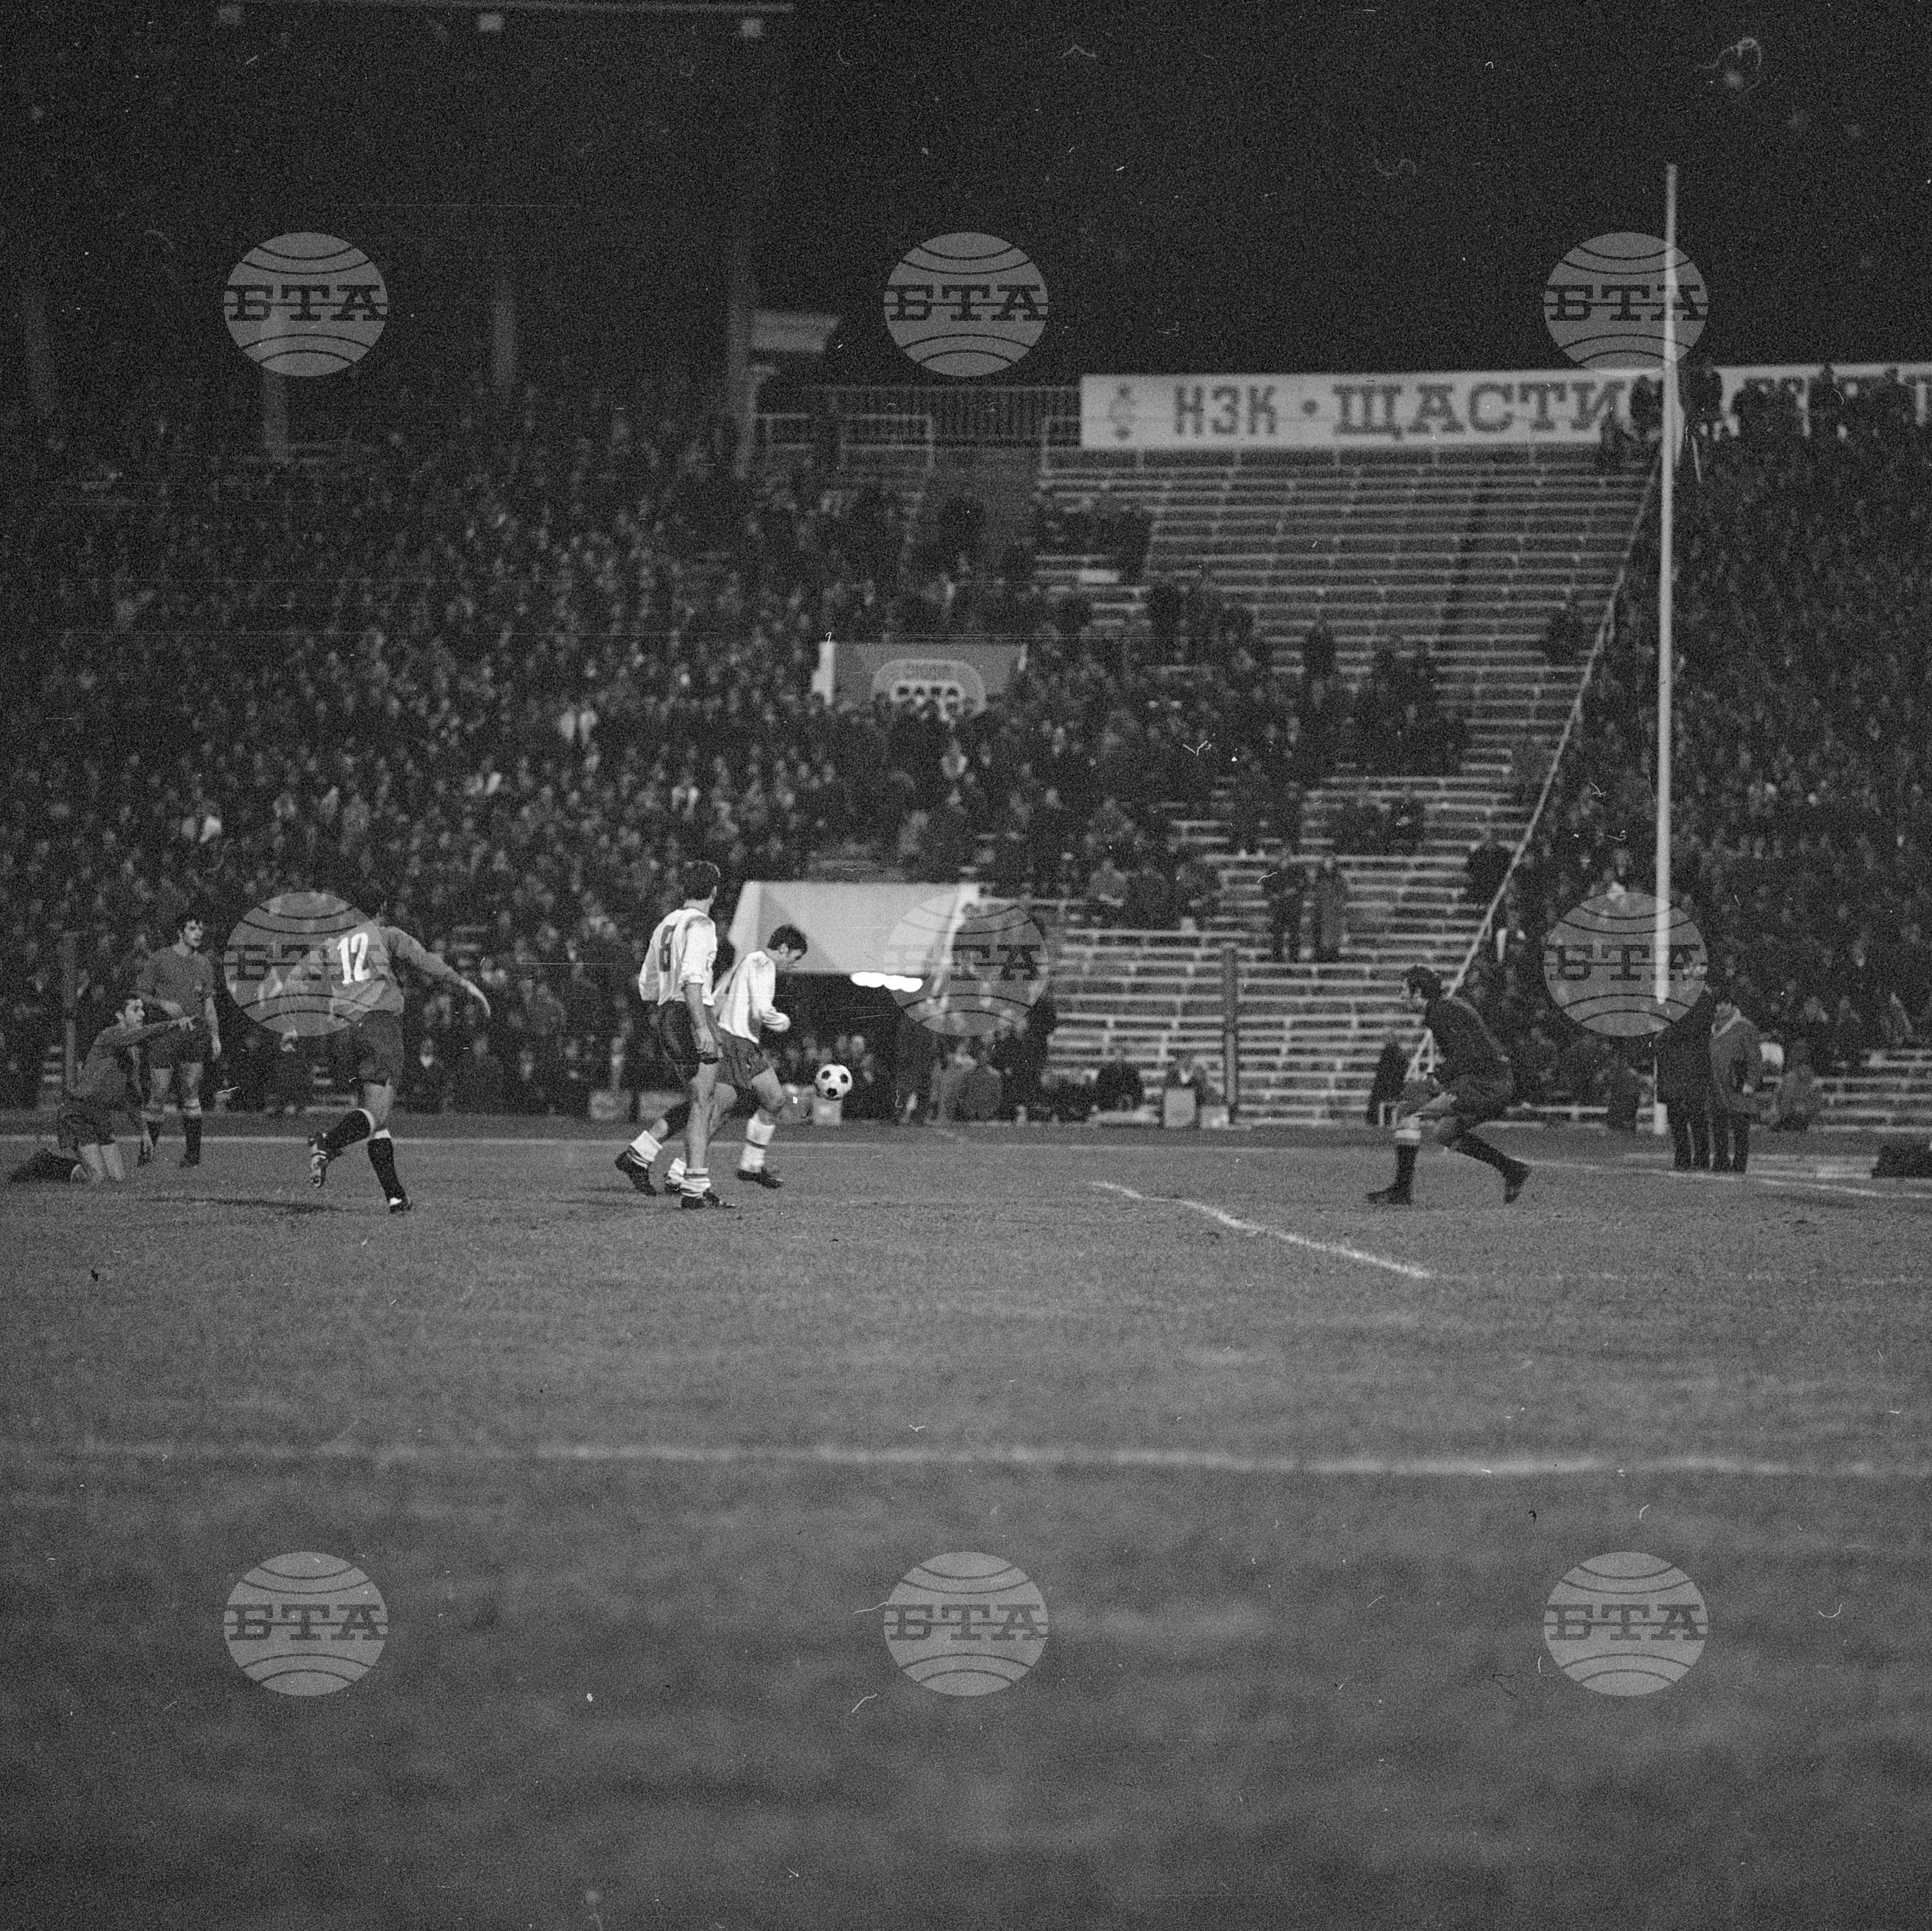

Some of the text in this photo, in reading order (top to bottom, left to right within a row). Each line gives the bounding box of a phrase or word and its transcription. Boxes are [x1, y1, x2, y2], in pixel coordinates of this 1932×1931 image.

[1173, 383, 1630, 440] НЗК ЩАСТИ
[337, 932, 370, 984] 12
